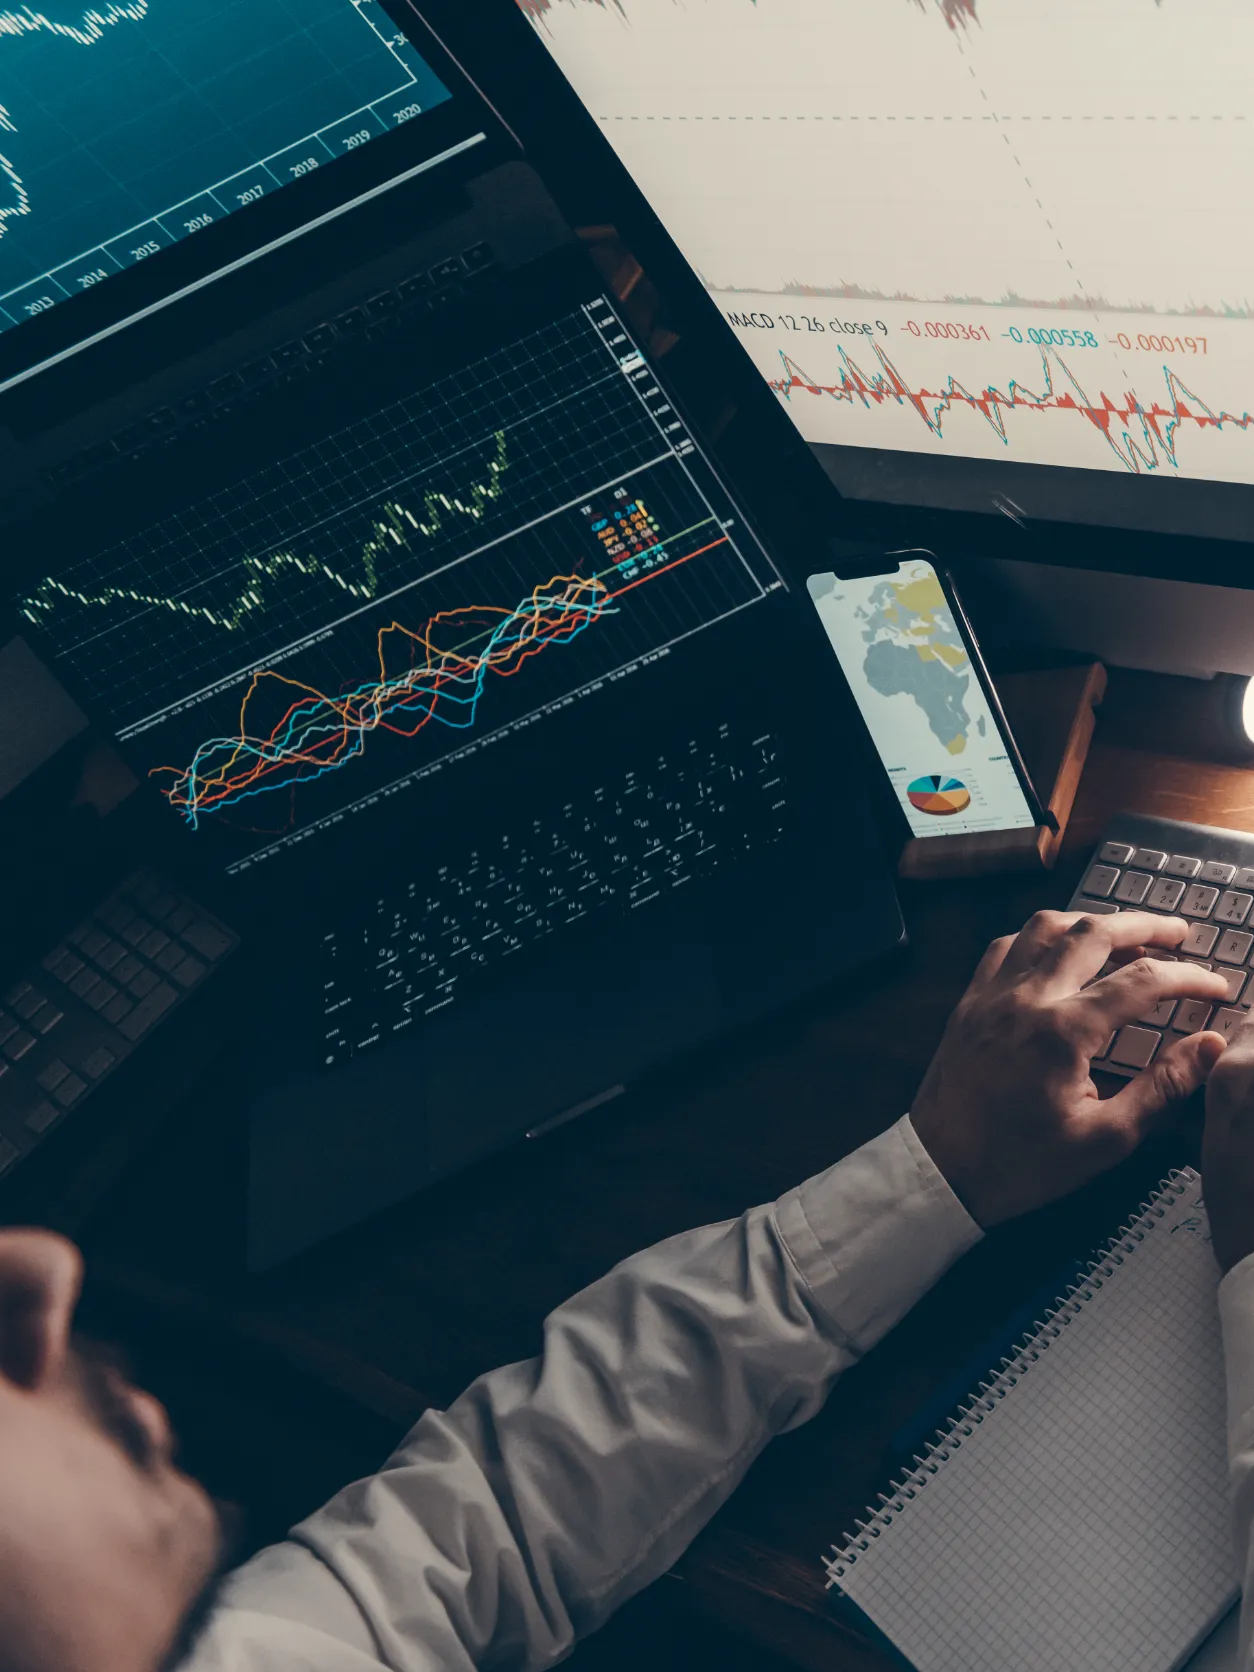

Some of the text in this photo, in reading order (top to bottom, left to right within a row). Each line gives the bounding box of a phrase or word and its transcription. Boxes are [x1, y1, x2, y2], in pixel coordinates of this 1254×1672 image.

[393, 103, 421, 124] 2020
[342, 129, 371, 150] 2019
[290, 157, 319, 178] 2018
[237, 185, 265, 205] 2017
[183, 213, 213, 233] 2016
[131, 240, 160, 261] 2015
[77, 268, 108, 288] 2014
[25, 296, 55, 316] 2013
[726, 312, 1207, 354] MACD 12 26 close 9 -0.000361 -0.000558 -0.000197
[1160, 895, 1167, 904] 2
[1193, 902, 1200, 911] 3
[1226, 909, 1233, 918] 4
[1195, 934, 1202, 944] E
[1230, 942, 1238, 953] R
[1153, 1003, 1162, 1014] X
[1188, 1012, 1195, 1023] C
[1224, 1019, 1232, 1031] V
